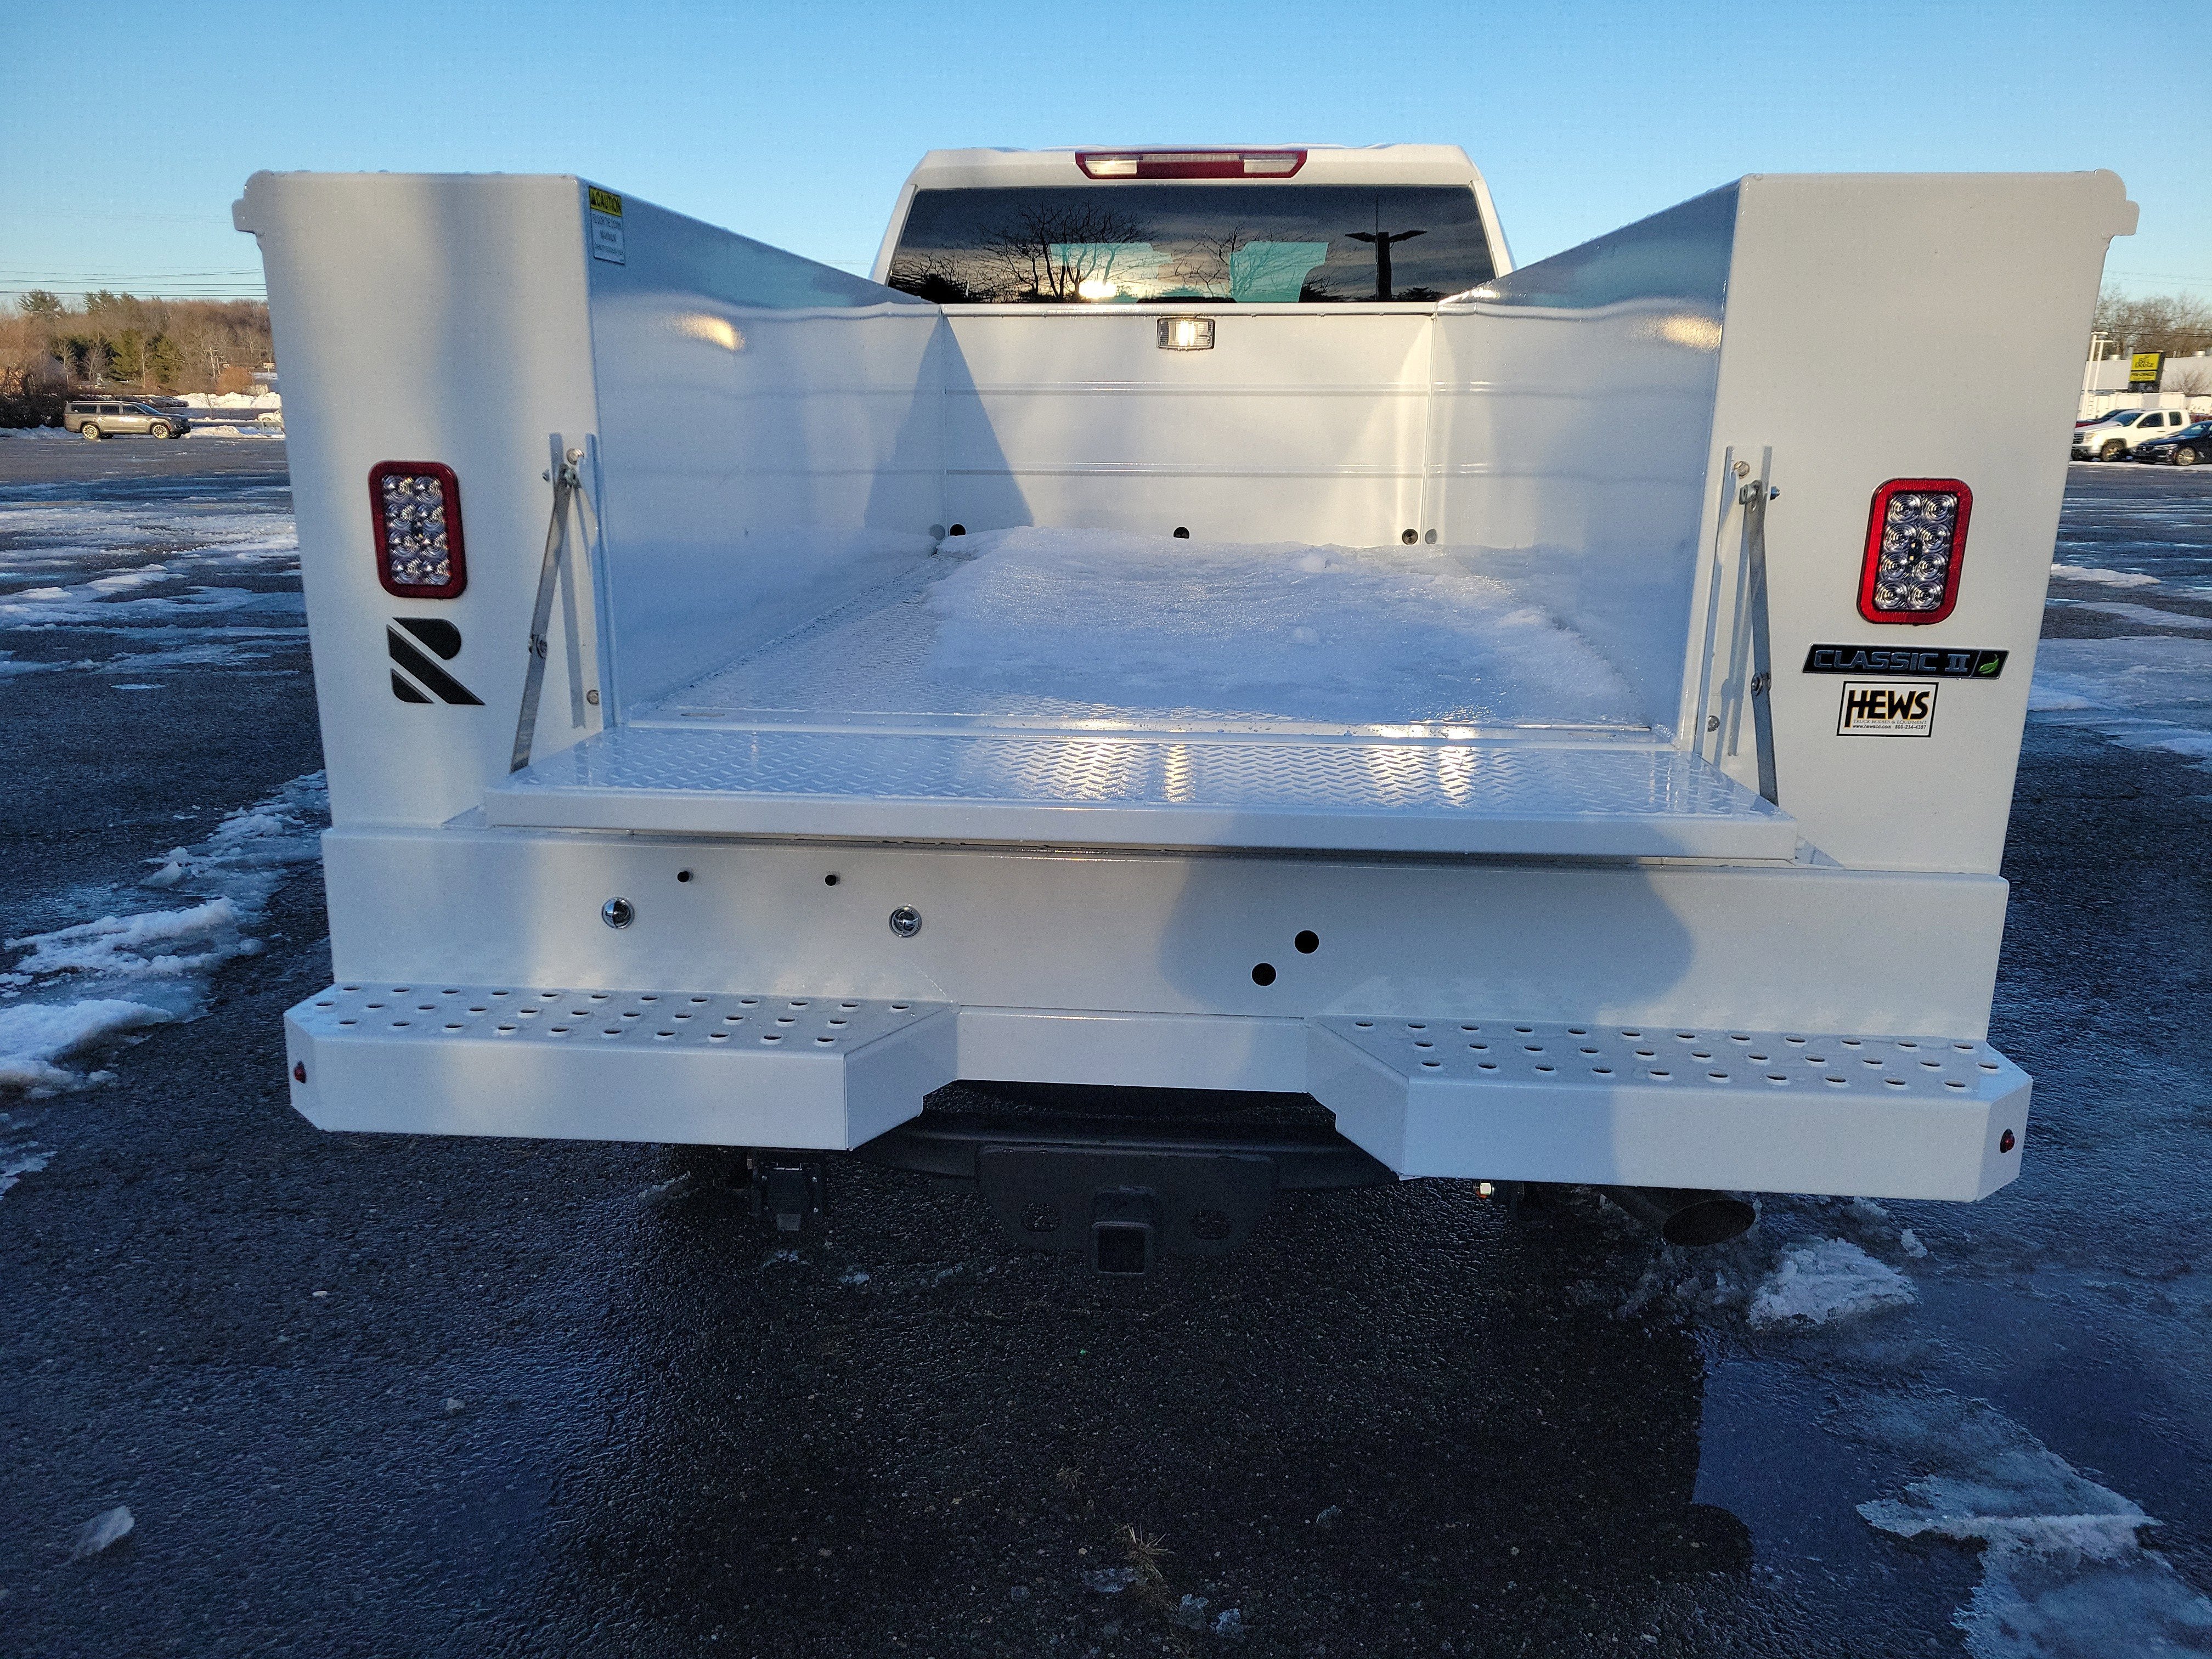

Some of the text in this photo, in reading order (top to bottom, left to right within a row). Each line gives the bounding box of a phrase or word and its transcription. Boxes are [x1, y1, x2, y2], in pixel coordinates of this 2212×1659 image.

[595, 190, 622, 213] CAUTION
[1814, 650, 1971, 673] CLASSIC II
[1843, 689, 1931, 728] HEWS
